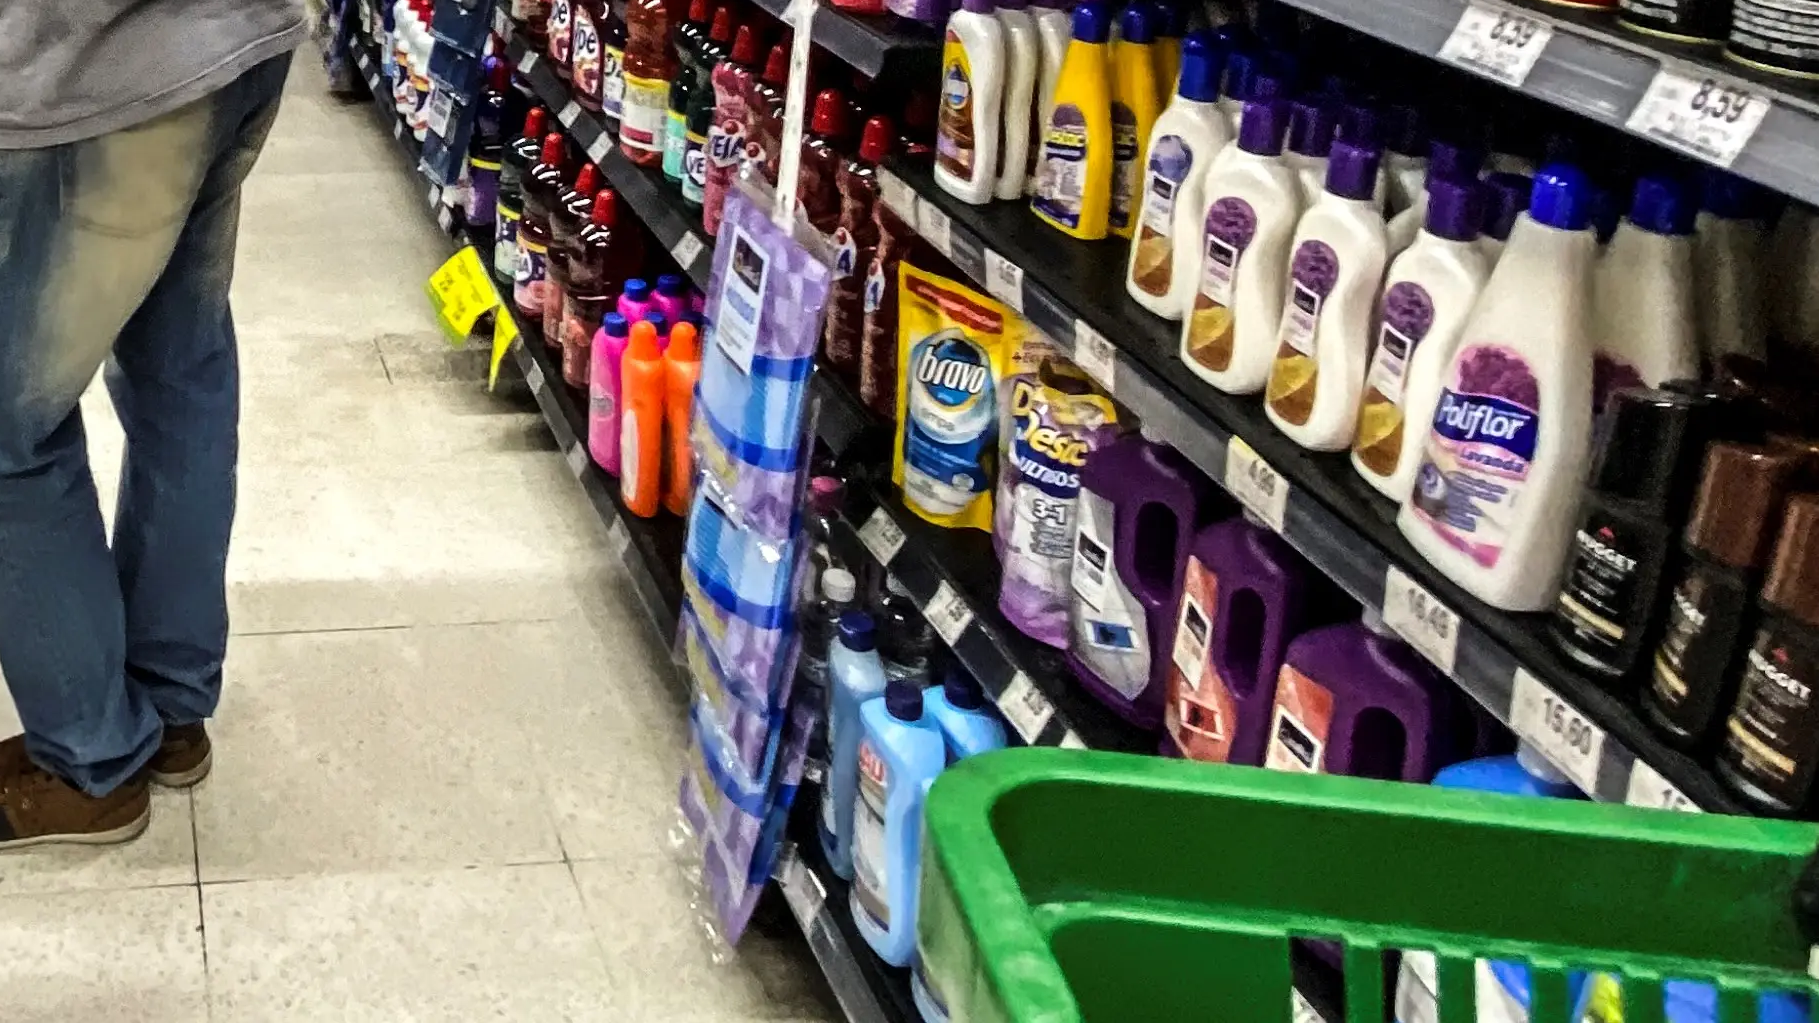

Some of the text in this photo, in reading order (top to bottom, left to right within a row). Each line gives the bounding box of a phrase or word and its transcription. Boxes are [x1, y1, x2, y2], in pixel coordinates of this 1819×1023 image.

[1691, 78, 1748, 123] 8,59
[915, 345, 986, 395] bravo
[1437, 393, 1531, 439] Poliflor
